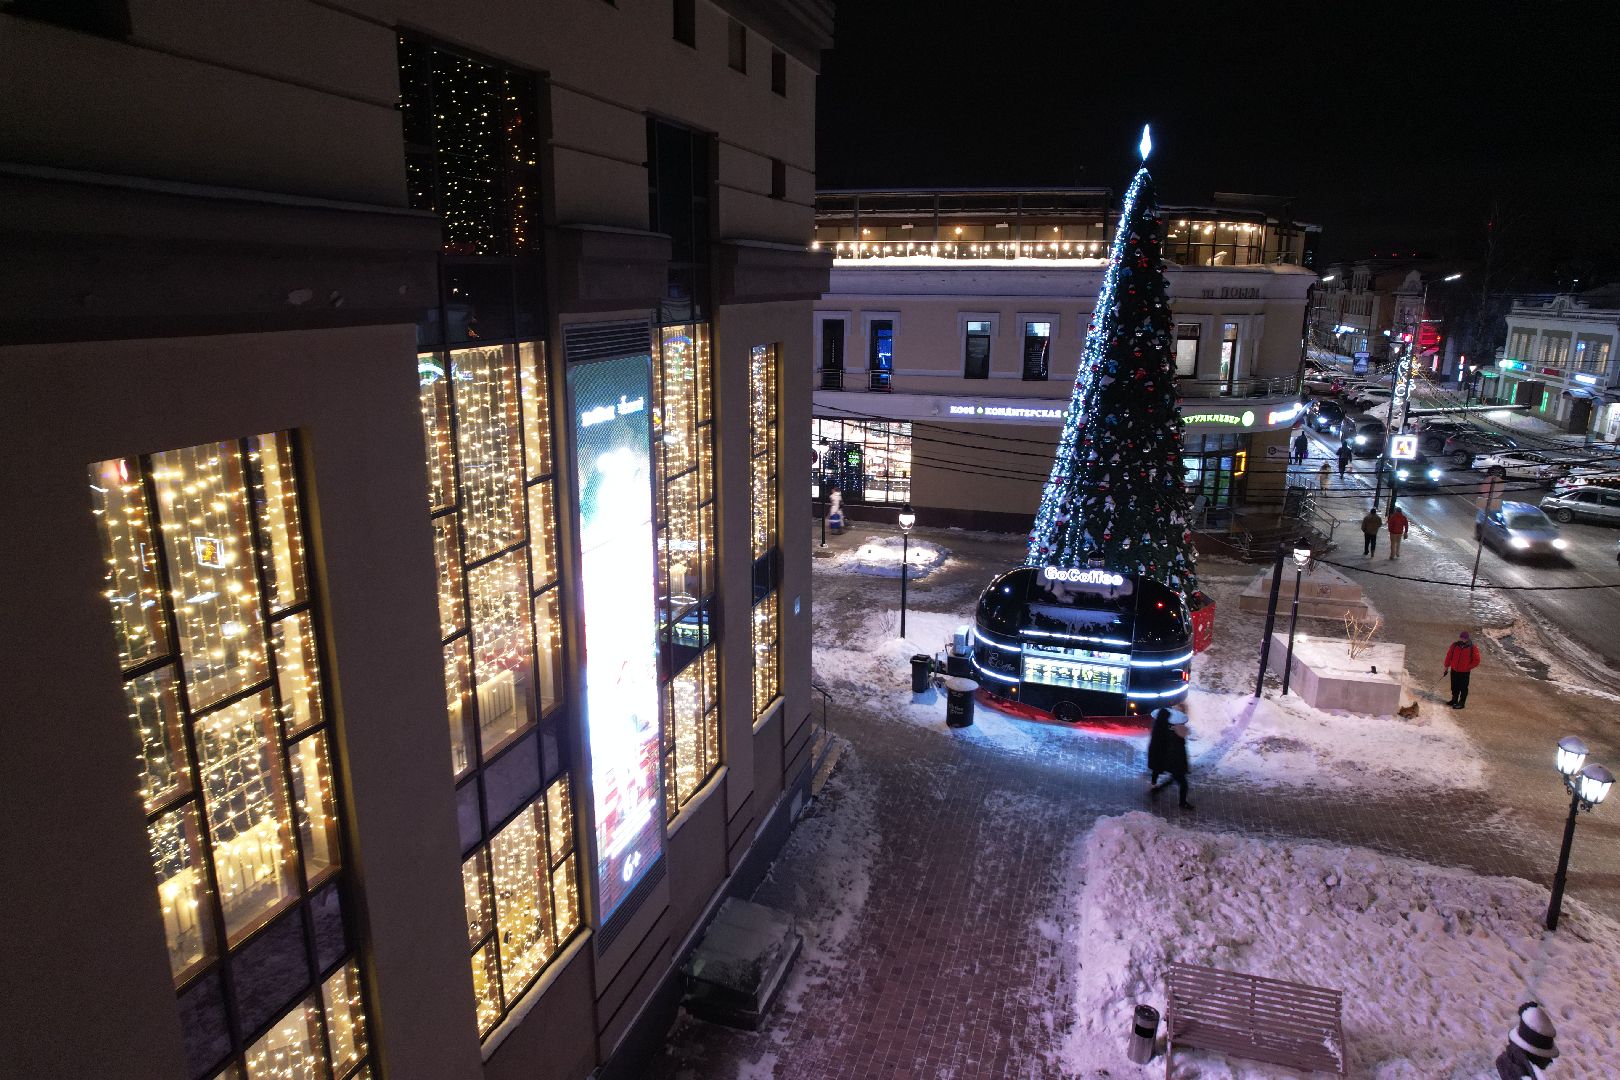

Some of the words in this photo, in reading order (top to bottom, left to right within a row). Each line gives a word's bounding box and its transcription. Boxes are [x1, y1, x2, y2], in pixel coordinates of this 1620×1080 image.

[985, 407, 1061, 418] КОНДИТЕРСКАЯ
[1045, 566, 1123, 585] GoCoffee
[623, 850, 641, 882] 6+
